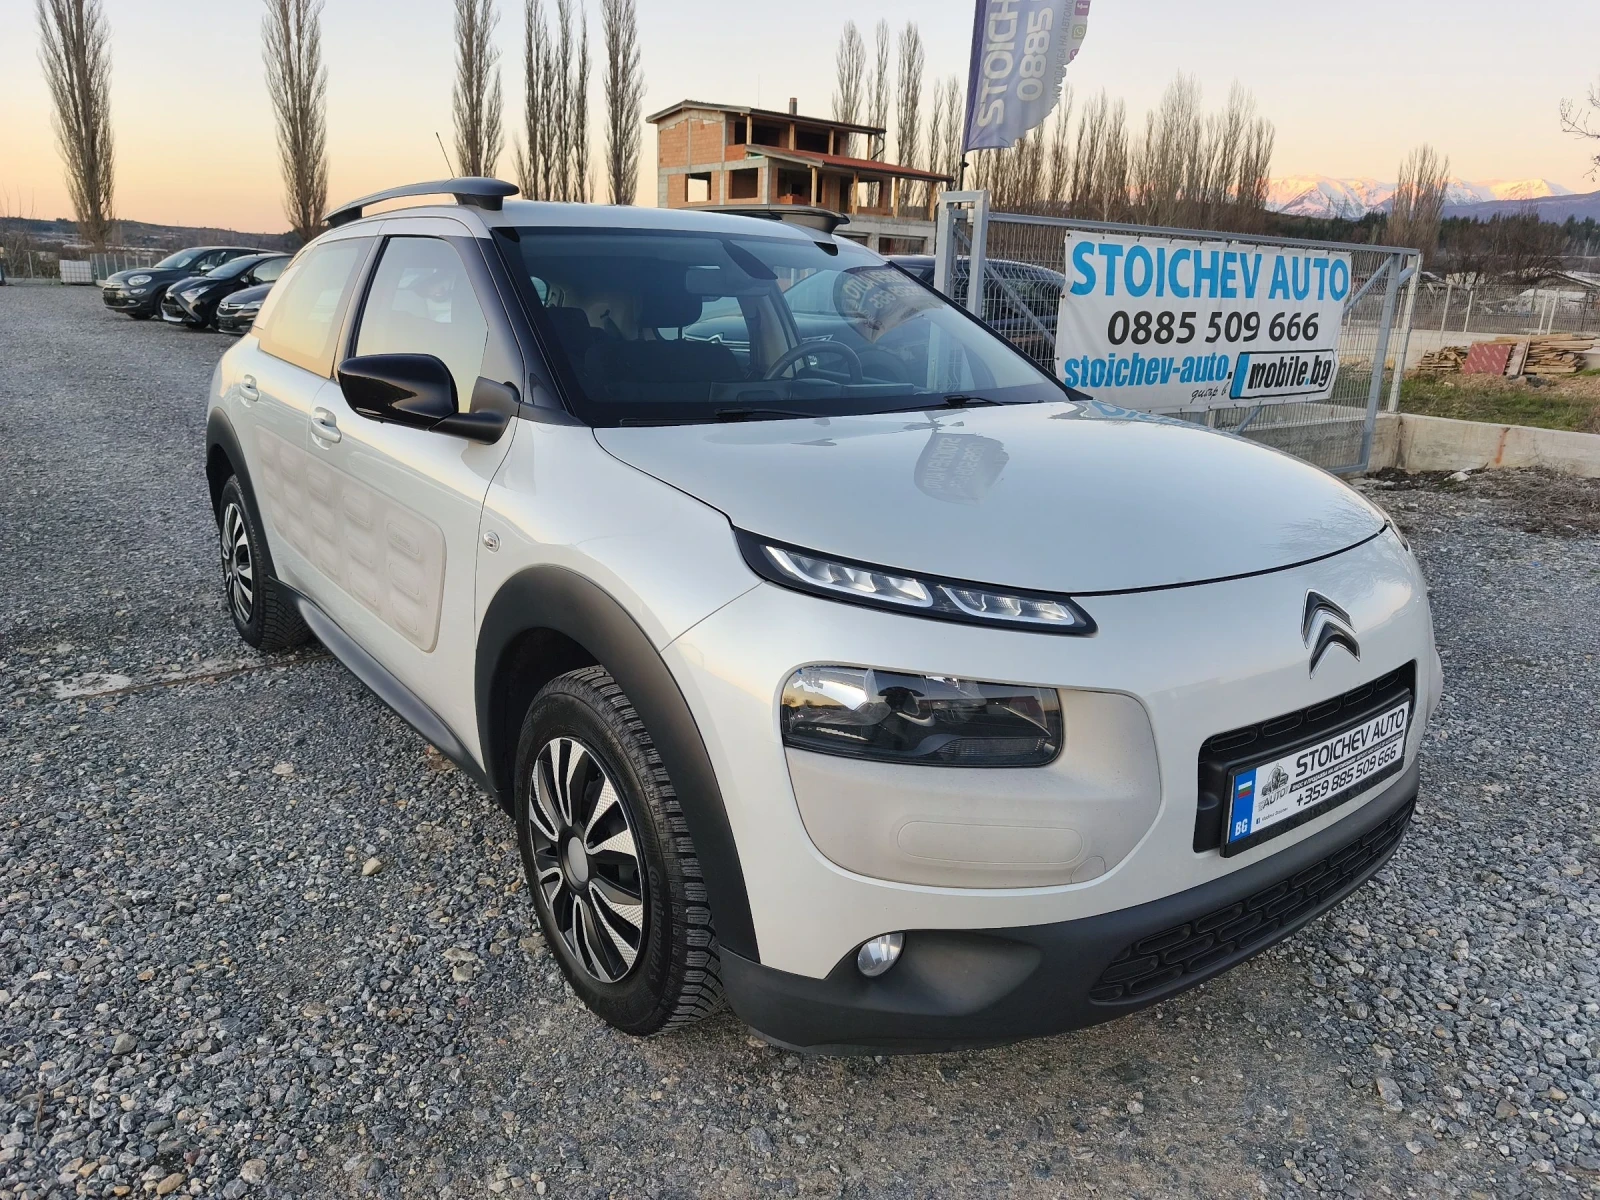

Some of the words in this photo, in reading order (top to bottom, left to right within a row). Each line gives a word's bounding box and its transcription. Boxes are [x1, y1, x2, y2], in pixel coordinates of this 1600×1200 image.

[1016, 7, 1054, 101] 0885
[1069, 240, 1262, 299] STOICHEV
[1268, 254, 1349, 301] AUTO
[1107, 310, 1197, 346] 0885
[1204, 311, 1260, 343] 509
[1268, 312, 1319, 342] 666
[1295, 724, 1371, 778] STOICHEV
[1371, 707, 1405, 742] AUTO
[1296, 779, 1330, 807] +359
[1331, 766, 1355, 792] 885
[1355, 755, 1377, 779] 509
[1378, 743, 1398, 767] 666
[1234, 818, 1248, 837] BG
